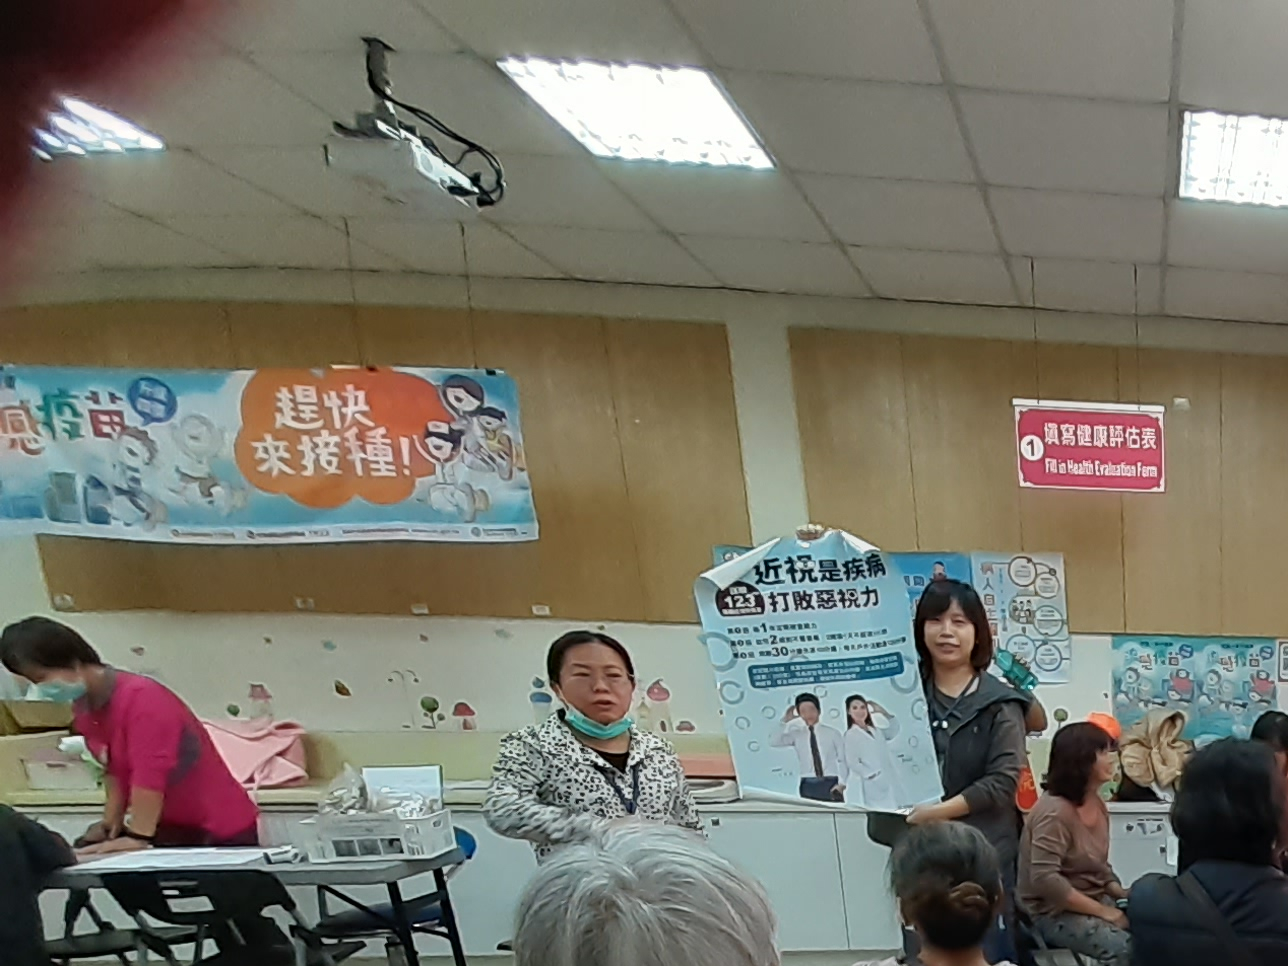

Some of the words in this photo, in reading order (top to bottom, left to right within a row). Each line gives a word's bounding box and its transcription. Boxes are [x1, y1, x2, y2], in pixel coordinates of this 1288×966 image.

[274, 384, 376, 430] 趕快
[1044, 422, 1157, 449] 填寫健康評估表
[1067, 460, 1094, 476] Health
[1095, 460, 1136, 477] Evaluation
[1137, 462, 1157, 478] Form
[753, 554, 887, 585] 近視是疾病
[769, 586, 879, 613] 打敗惡視力
